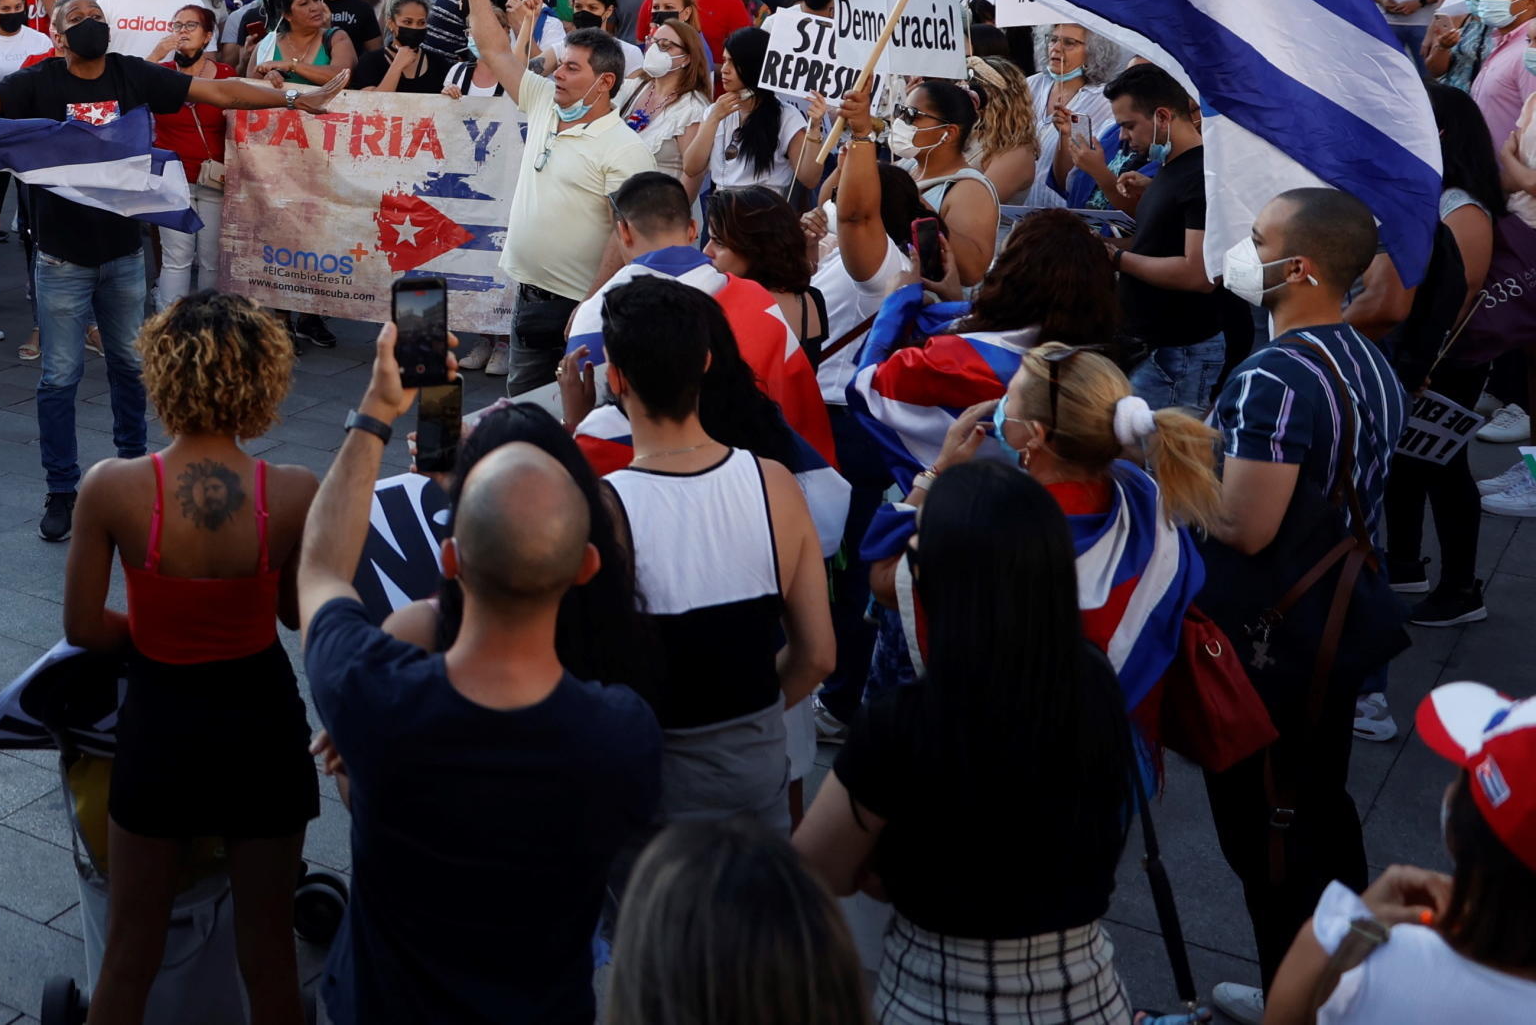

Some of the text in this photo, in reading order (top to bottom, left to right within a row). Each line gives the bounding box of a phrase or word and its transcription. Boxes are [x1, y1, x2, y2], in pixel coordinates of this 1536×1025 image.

[116, 16, 174, 33] adidas
[234, 108, 445, 161] PATRIA
[462, 118, 502, 162] Y
[248, 276, 376, 303] www.somosmascuba.com
